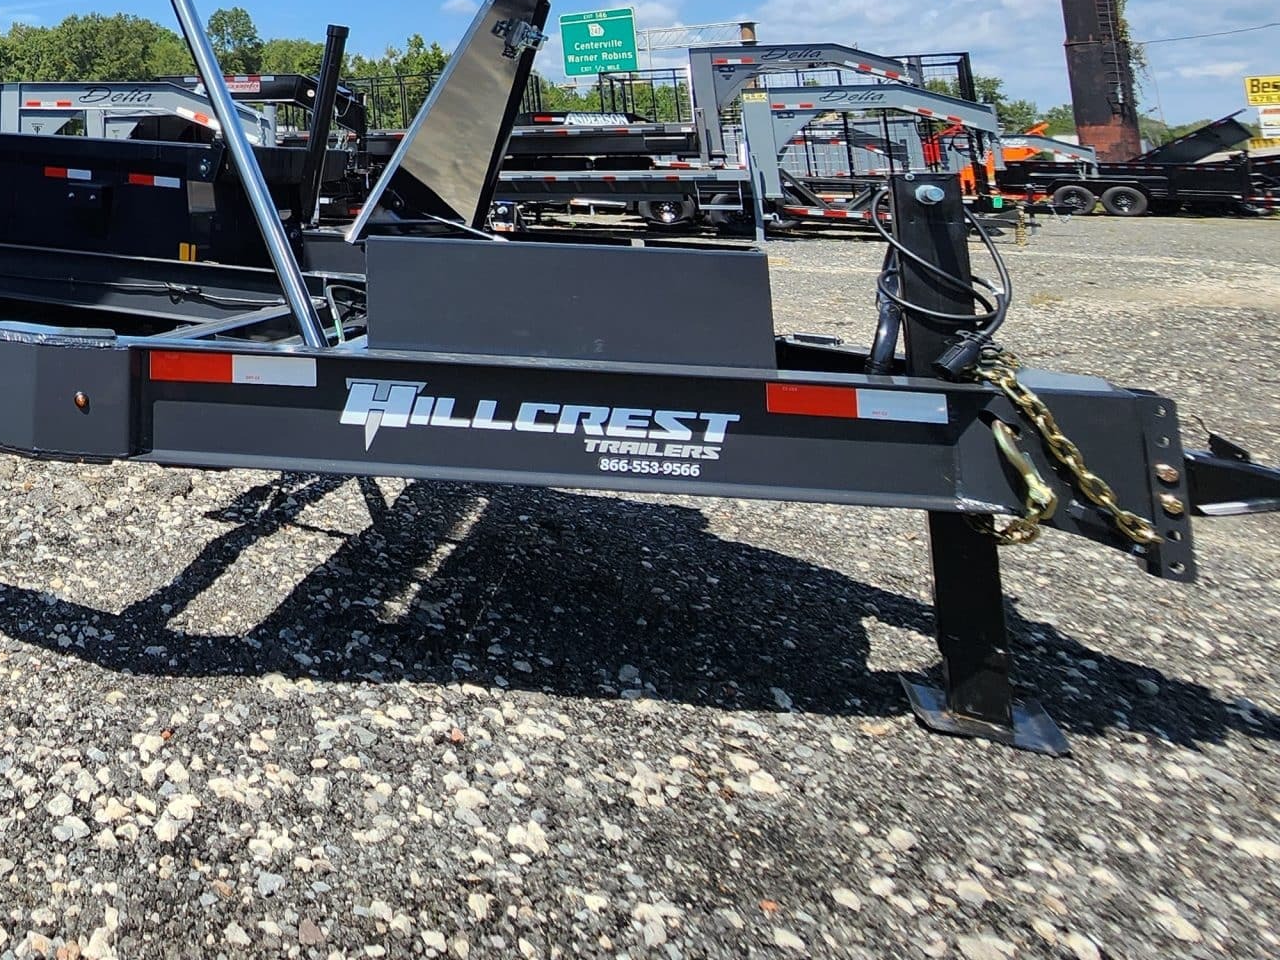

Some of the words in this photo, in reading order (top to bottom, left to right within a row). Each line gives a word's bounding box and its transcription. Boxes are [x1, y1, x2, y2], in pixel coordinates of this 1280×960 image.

[574, 40, 623, 51] Centerville
[567, 54, 598, 63] Warner
[601, 51, 633, 61] Robins
[761, 48, 822, 60] Delta
[78, 86, 153, 103] Delta
[819, 89, 885, 102] Delta
[564, 113, 630, 125] ANDERSON
[338, 377, 741, 452] HILLCREST
[584, 439, 722, 460] TRAILERS
[599, 458, 701, 477] 866-553-9566
